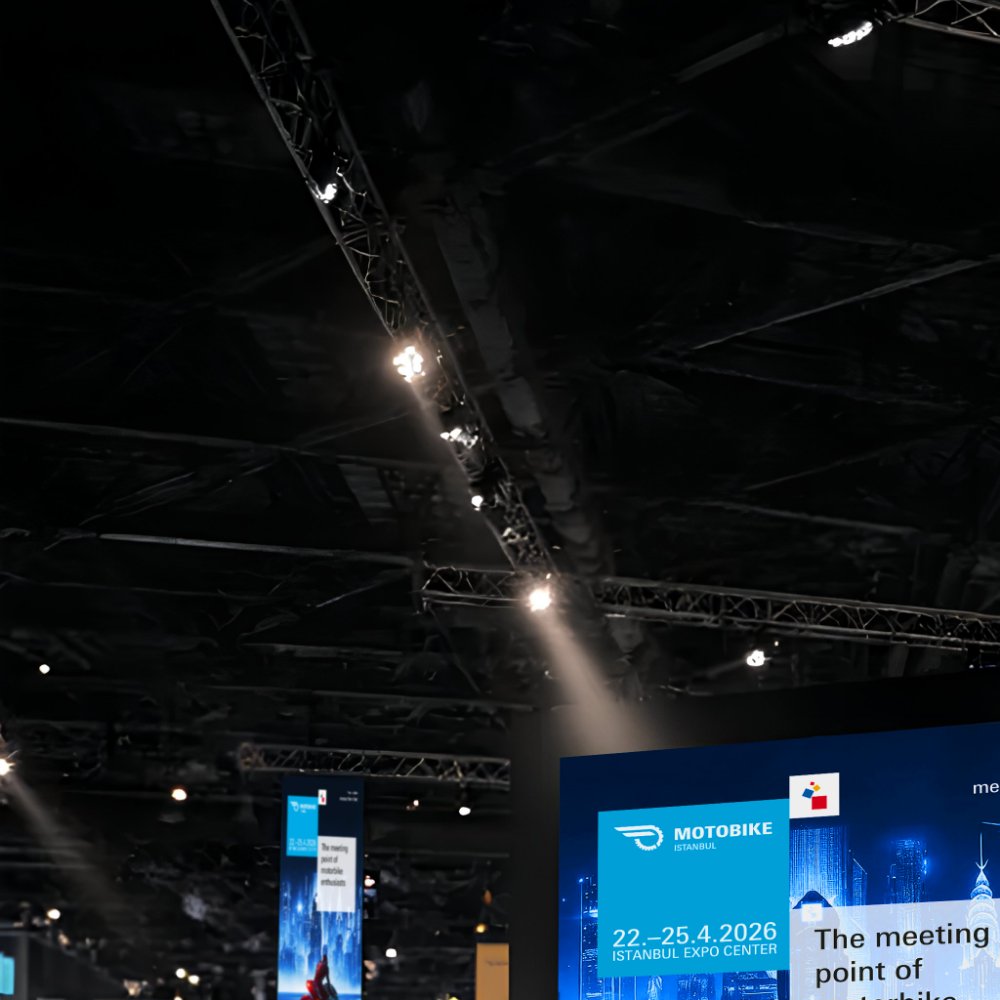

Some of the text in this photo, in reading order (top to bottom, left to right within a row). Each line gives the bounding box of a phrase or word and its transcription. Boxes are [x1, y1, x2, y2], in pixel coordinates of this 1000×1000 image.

[674, 821, 773, 841] MOTOBIKE
[674, 842, 717, 852] ISTANBUL
[612, 922, 778, 948] 22.–25.4.2026
[814, 922, 989, 950] The meeting
[612, 943, 778, 962] ISTANBUL EXPO CENTER
[815, 957, 924, 989] point of
